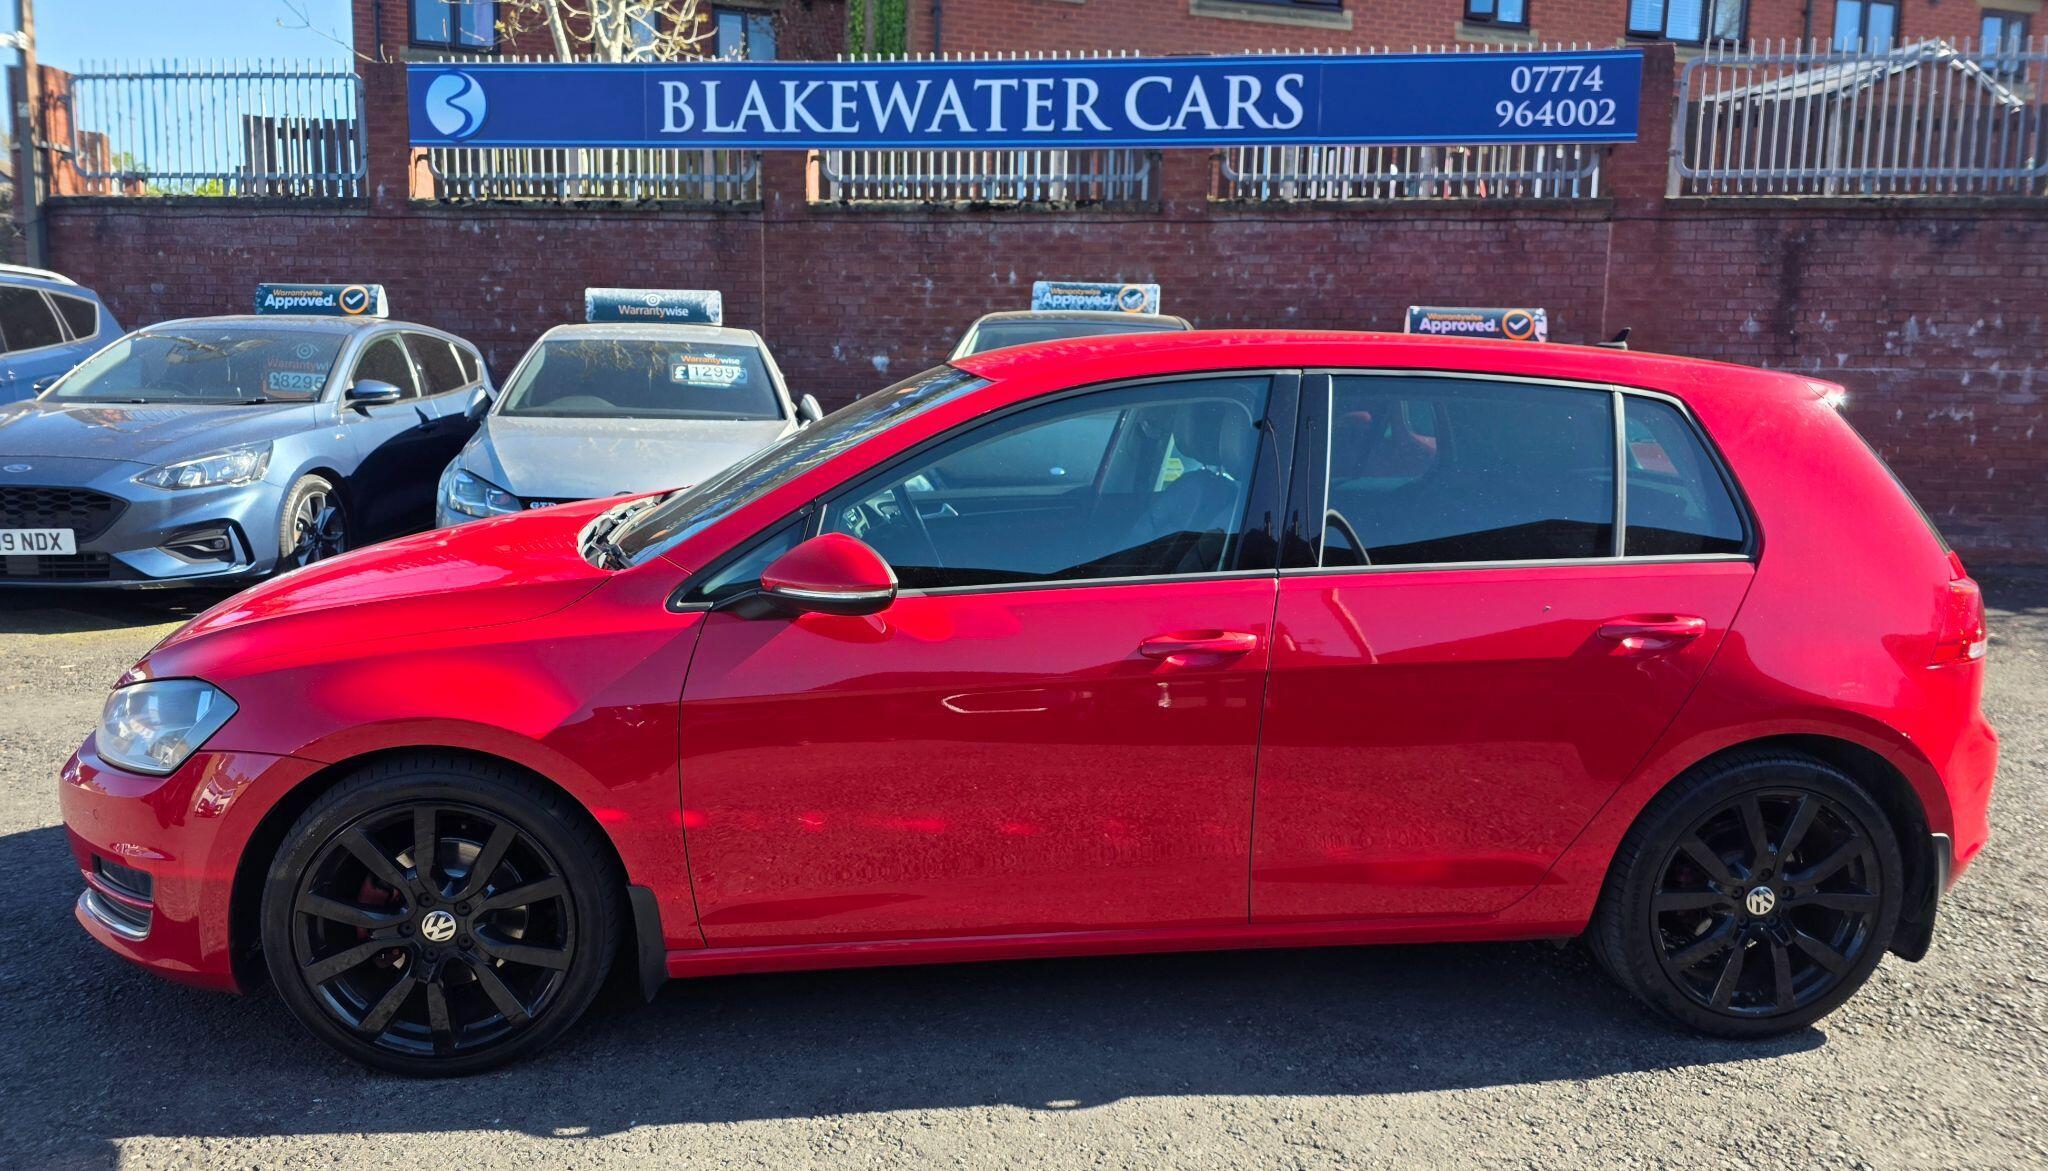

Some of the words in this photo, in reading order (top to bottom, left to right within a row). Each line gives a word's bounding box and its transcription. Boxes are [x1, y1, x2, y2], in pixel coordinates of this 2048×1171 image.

[1511, 64, 1604, 93] 07774
[658, 78, 1112, 133] BLAKEWATER
[1124, 73, 1304, 131] CARS
[1495, 98, 1616, 127] 964002
[272, 289, 323, 297] Warrantywise
[618, 304, 689, 318] Warrantywise
[681, 354, 741, 365] Warrantywise
[0, 533, 15, 550] 9
[20, 532, 62, 551] NDX
